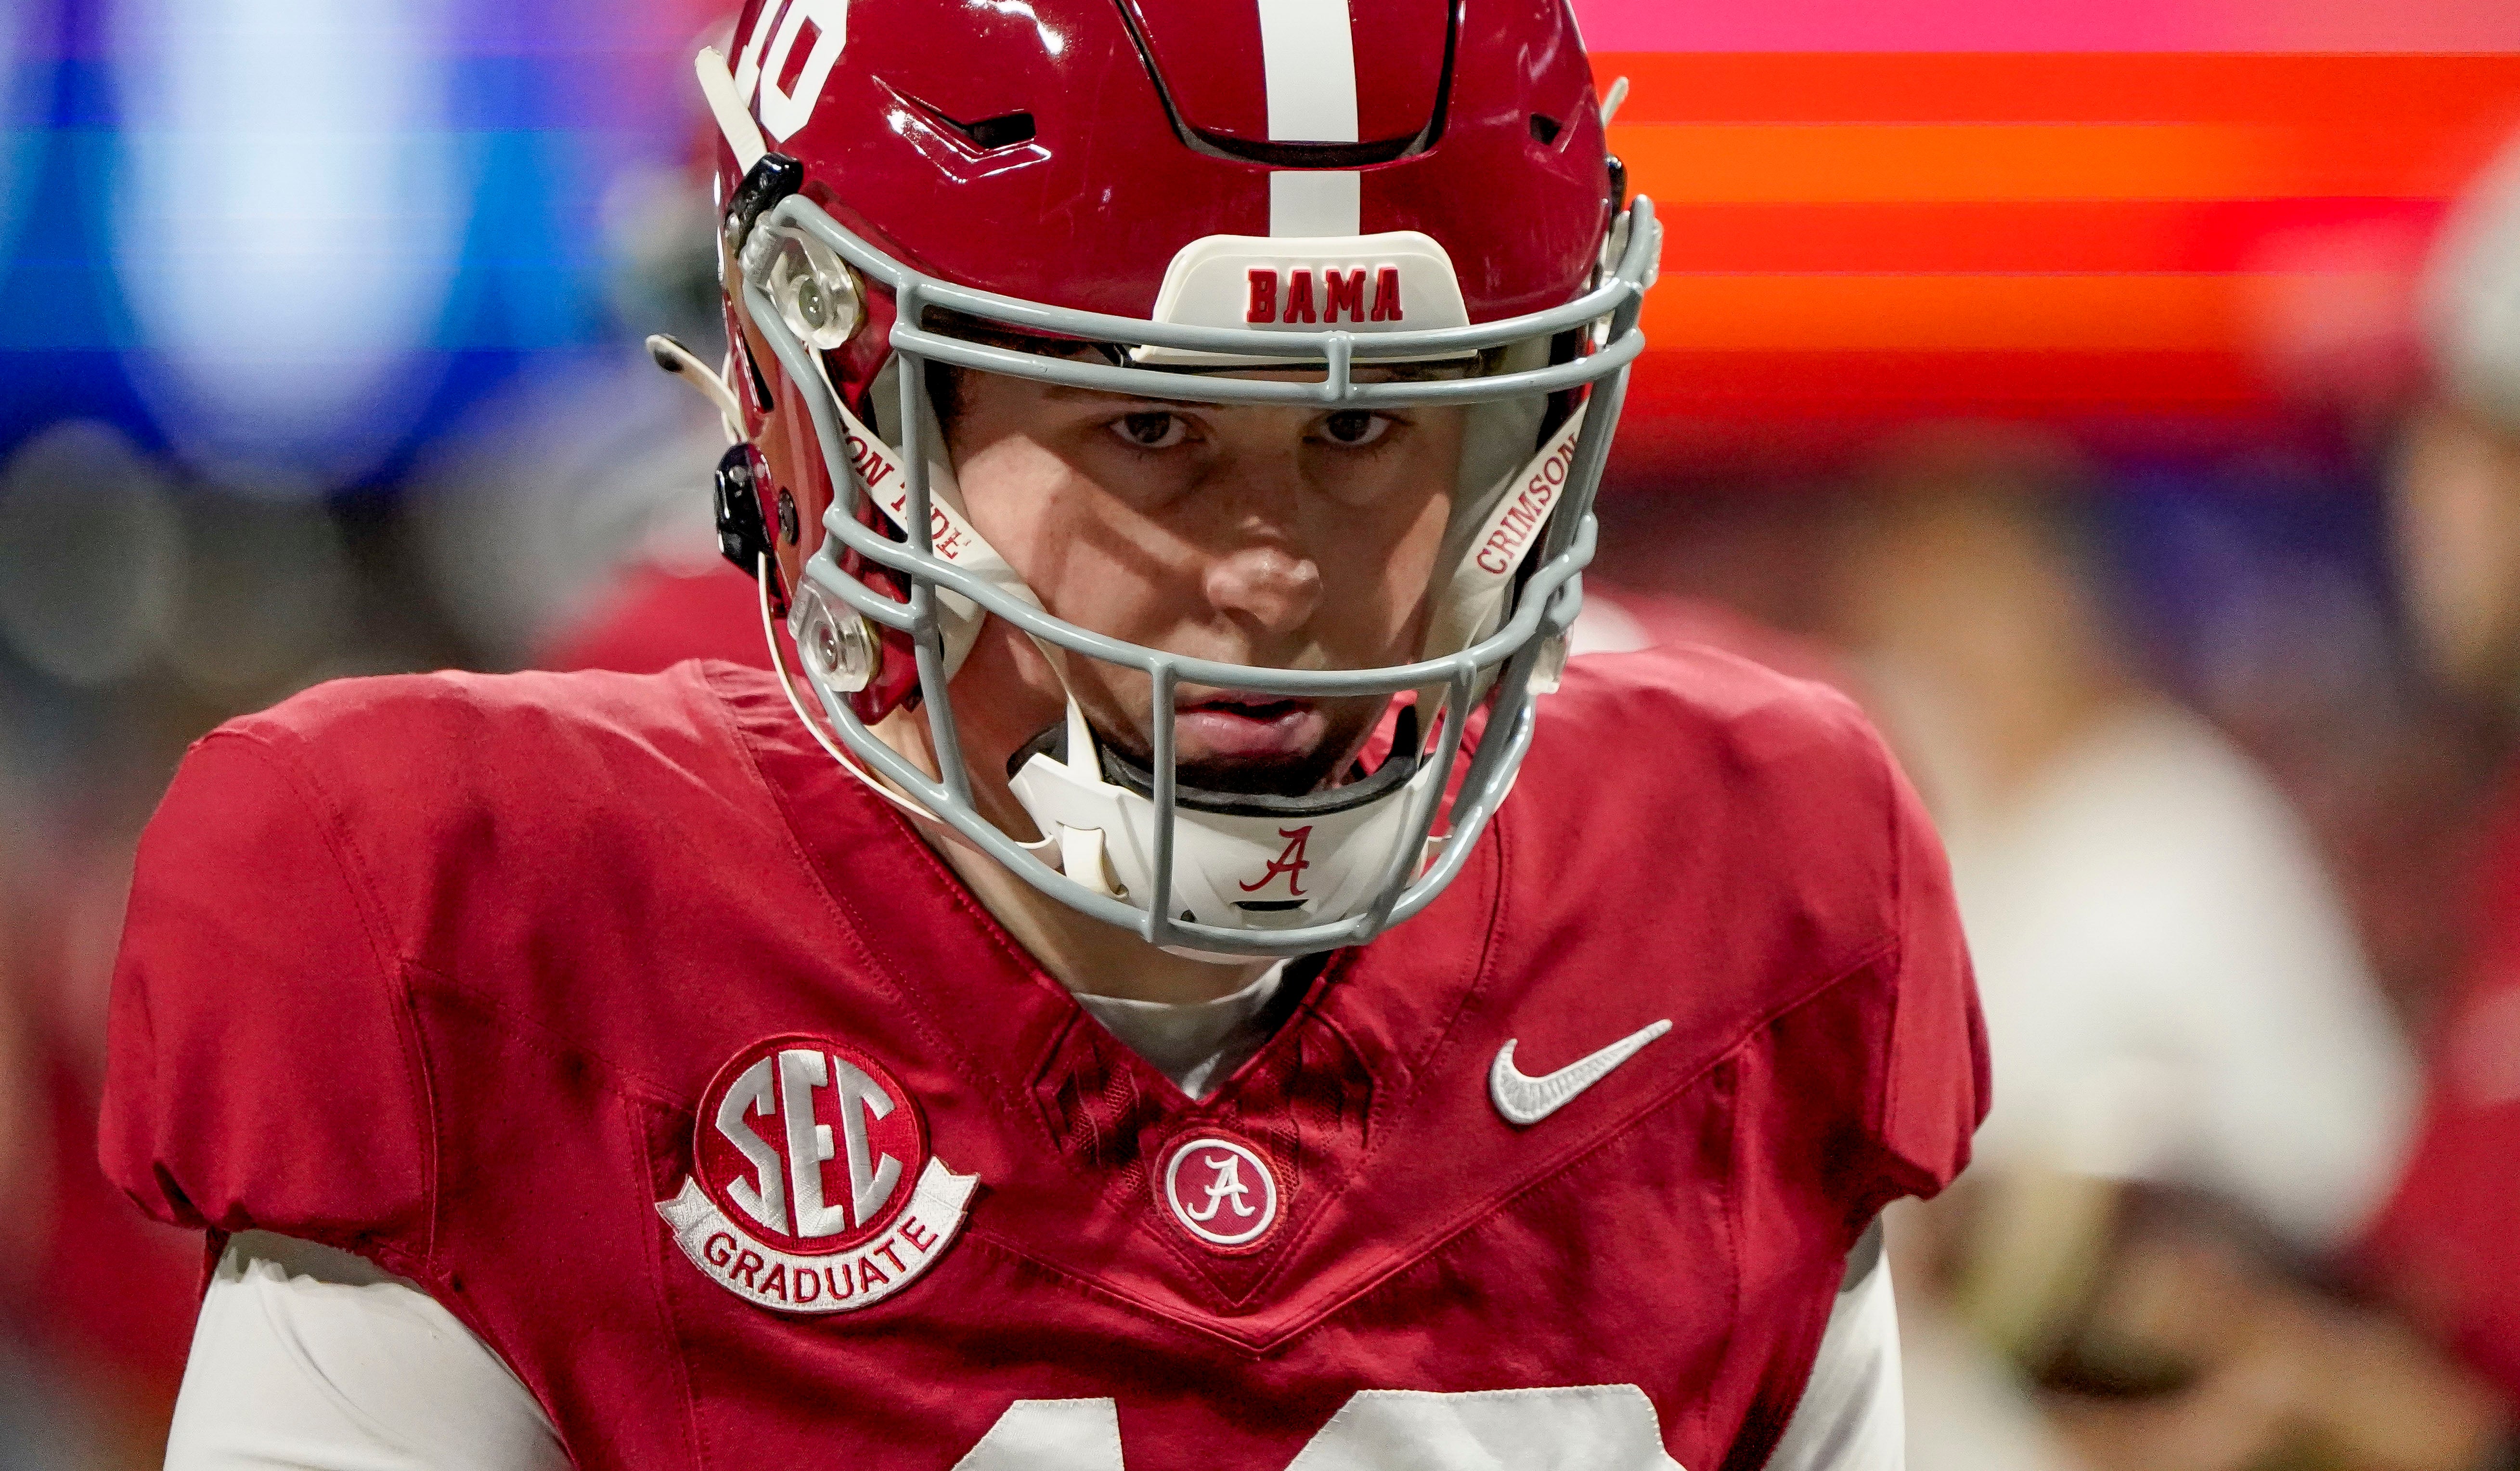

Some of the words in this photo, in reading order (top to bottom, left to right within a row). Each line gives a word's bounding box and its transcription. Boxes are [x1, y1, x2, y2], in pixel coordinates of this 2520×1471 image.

[1247, 267, 1404, 324] BAMA
[839, 418, 895, 488] ON
[1476, 431, 1577, 574] CRIMSON
[1239, 825, 1313, 896] A
[715, 1049, 904, 1238] SEC
[1187, 1154, 1256, 1221] A
[703, 1216, 939, 1303] GRADUATE
